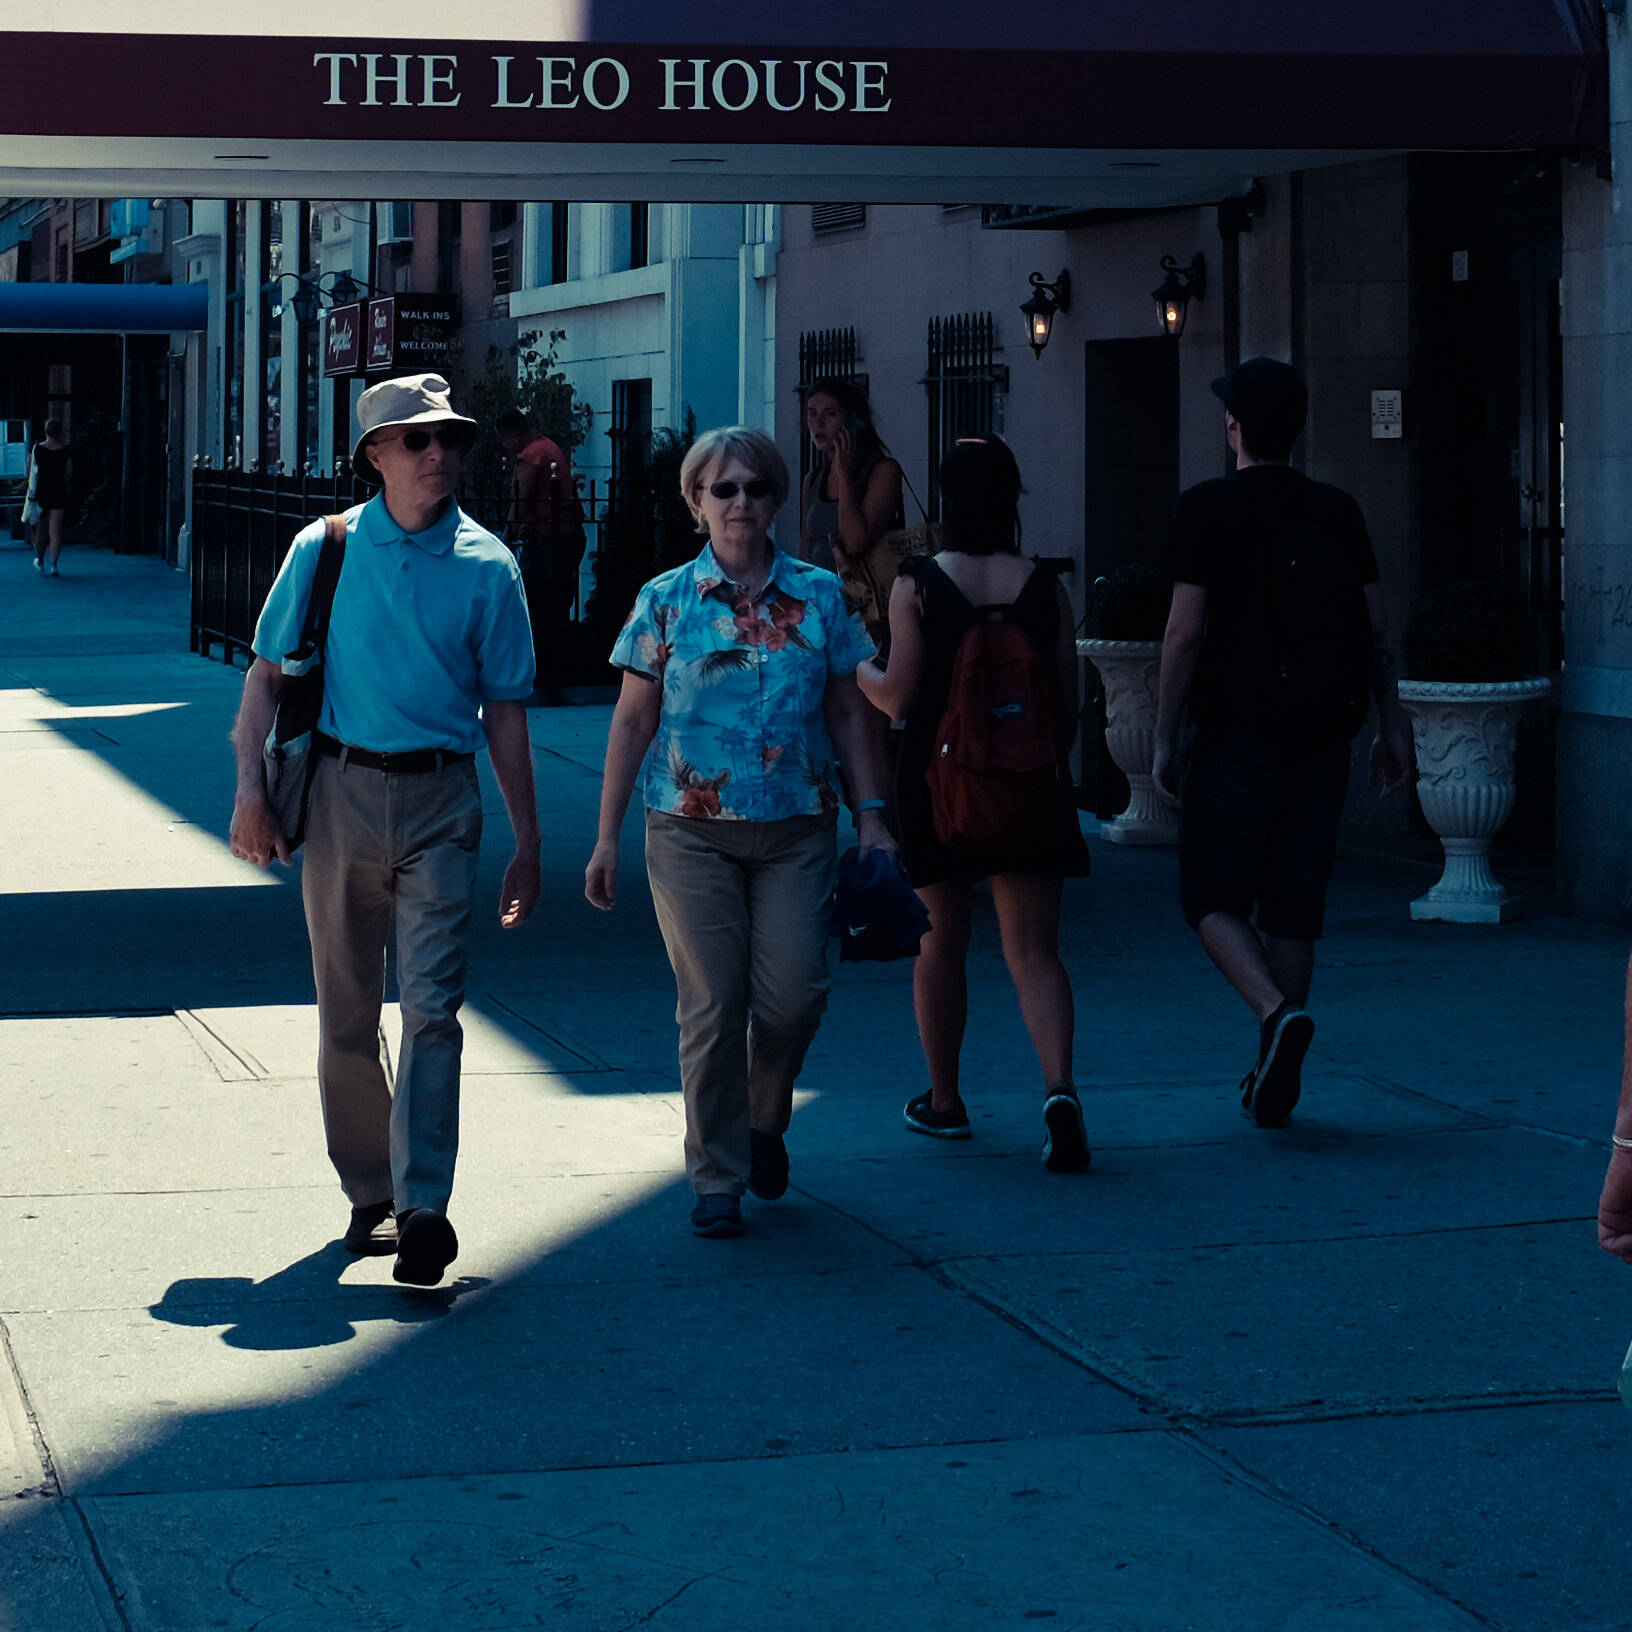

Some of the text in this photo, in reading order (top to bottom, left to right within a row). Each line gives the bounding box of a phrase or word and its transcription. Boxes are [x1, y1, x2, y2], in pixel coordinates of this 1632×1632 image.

[312, 51, 893, 114] THE LEO HOUSE
[400, 311, 450, 320] WALK-INS
